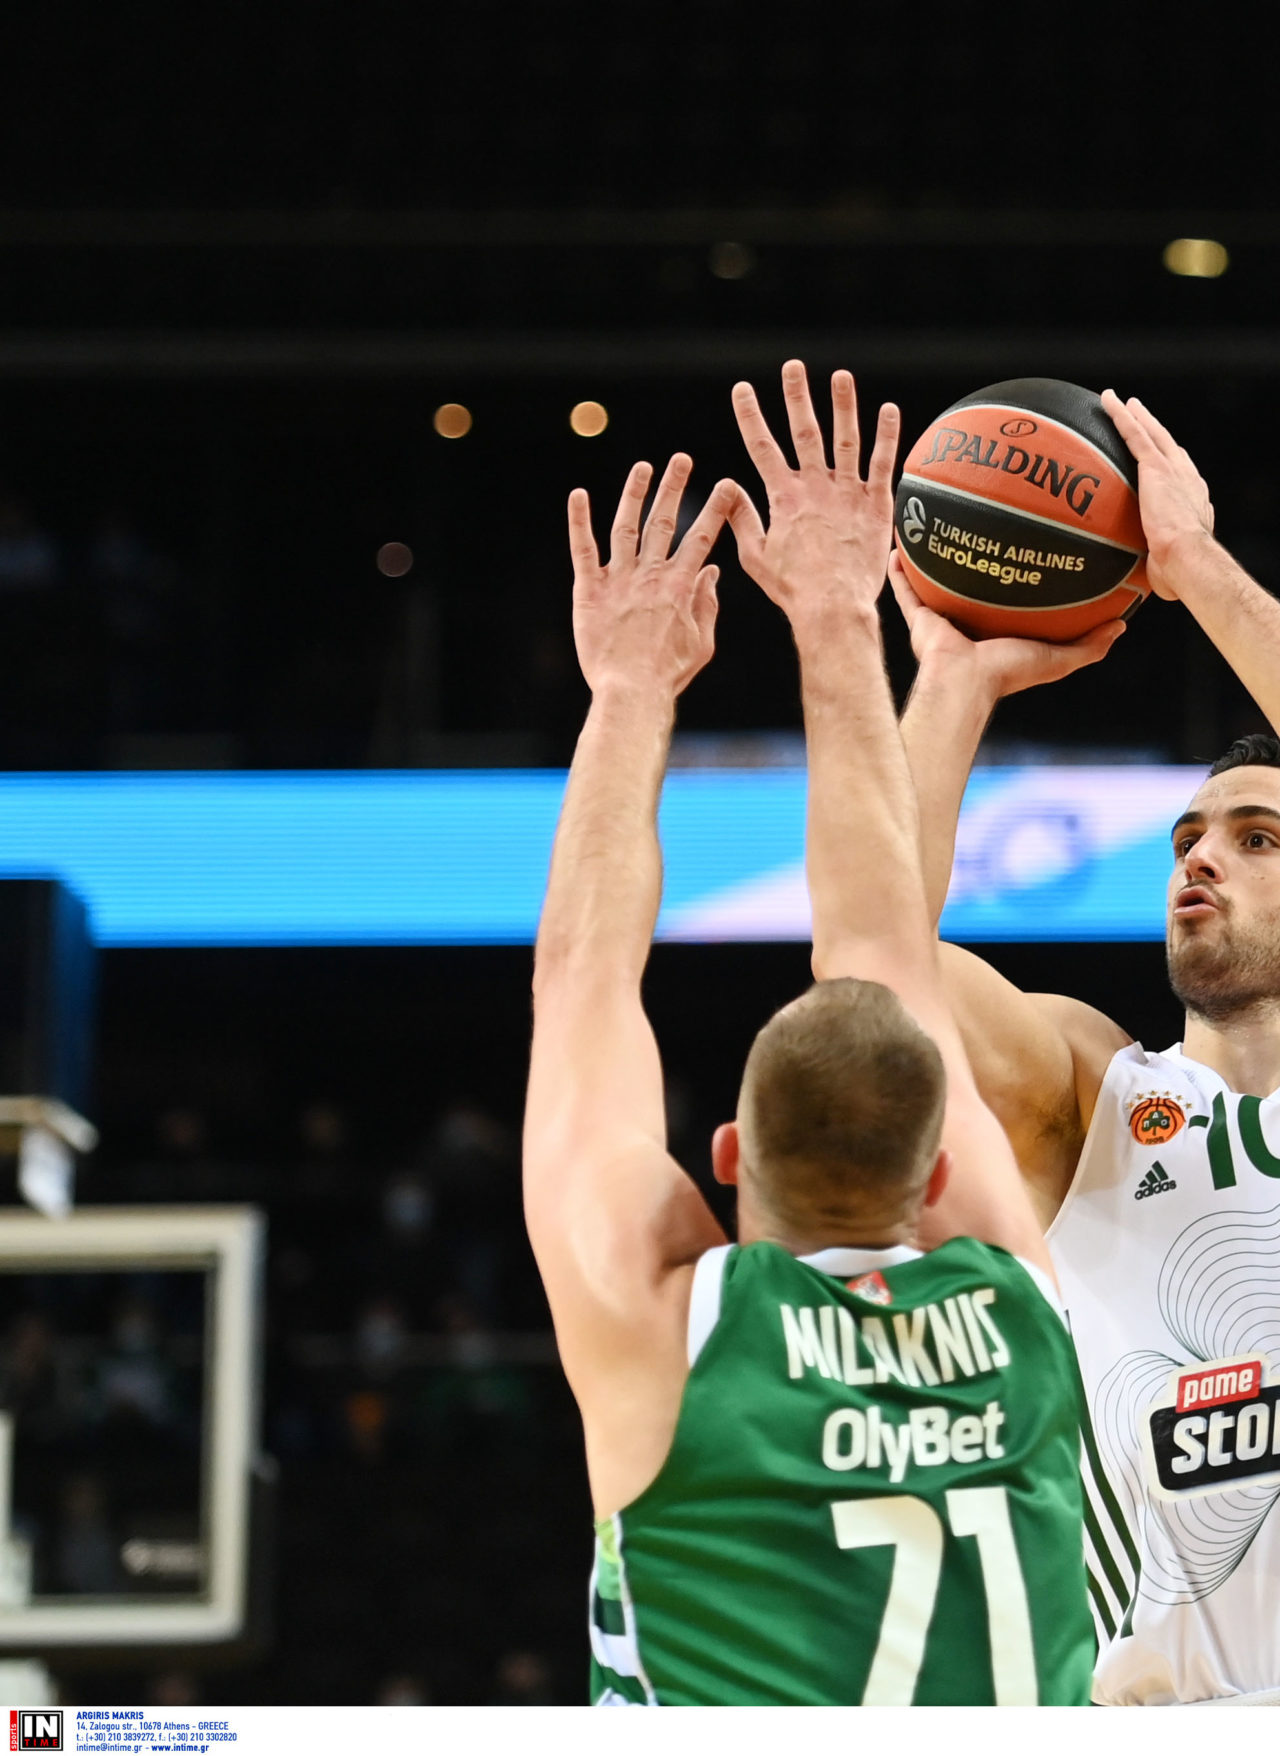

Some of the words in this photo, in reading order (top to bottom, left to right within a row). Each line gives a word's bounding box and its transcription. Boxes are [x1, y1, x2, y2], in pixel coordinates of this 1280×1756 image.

[920, 427, 1100, 517] SPALDING
[927, 537, 1042, 586] EuroLeague
[932, 517, 1000, 557] TURKISH
[1003, 546, 1085, 572] AIRLINES
[1134, 1179, 1177, 1201] adidas
[780, 1288, 1011, 1388] MILAKNIS
[1183, 1368, 1253, 1408] pame
[821, 1401, 1006, 1483] OlyBet
[830, 1486, 1038, 1706] 71
